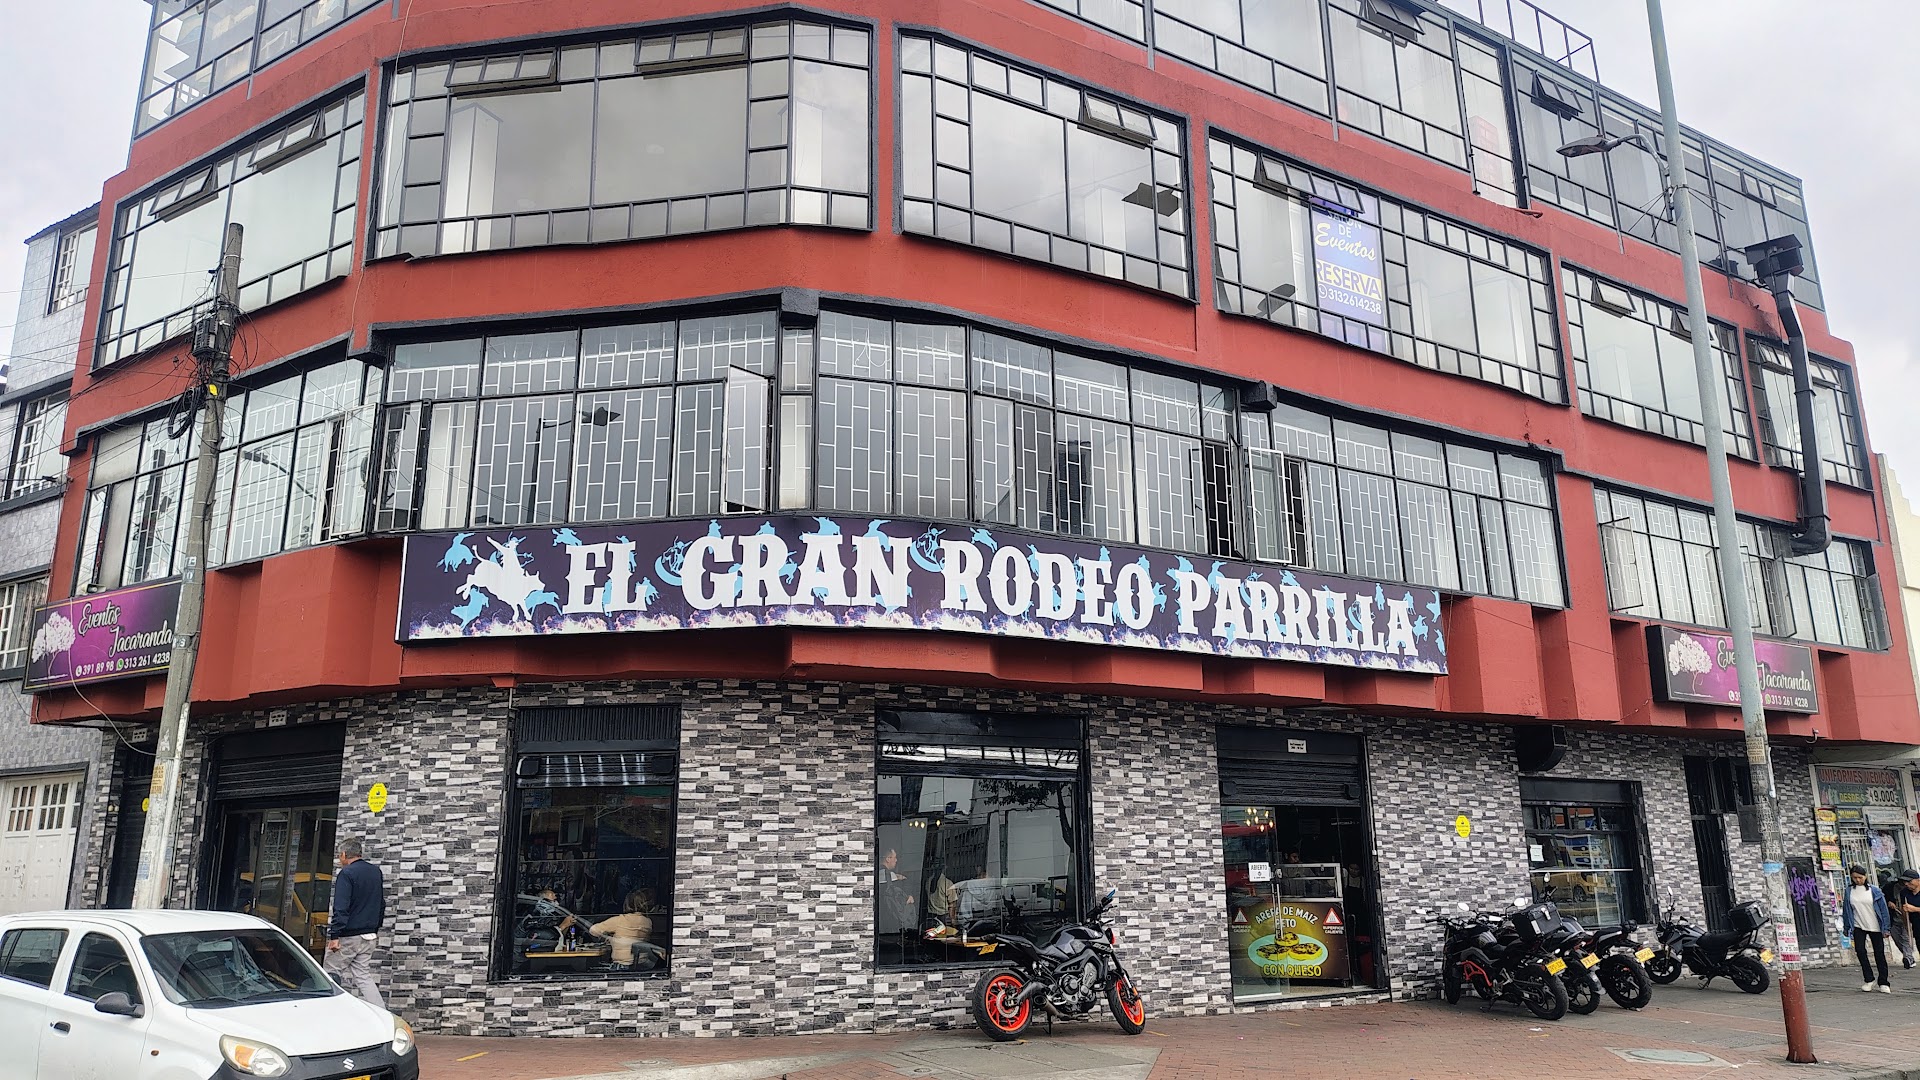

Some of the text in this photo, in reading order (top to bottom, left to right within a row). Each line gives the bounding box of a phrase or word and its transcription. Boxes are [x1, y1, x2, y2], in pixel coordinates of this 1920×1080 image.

[1315, 222, 1376, 261] Eventos
[1338, 224, 1352, 238] DE
[1317, 261, 1382, 300] RESERVA
[1328, 288, 1382, 315] 3132614238
[562, 534, 1419, 657] EL GRAN RODEO PARRILLA
[79, 601, 121, 637] Eventos
[109, 620, 172, 658] Jacaranda
[83, 651, 171, 676] 391 89 98 313 261 4238
[1757, 663, 1812, 692] Jacaranda
[1771, 694, 1783, 705] 313
[1783, 696, 1794, 707] 261
[1795, 697, 1809, 708] 4238
[1819, 768, 1863, 784] UNIFORMES
[1283, 906, 1294, 917] DE
[1263, 964, 1322, 977] CON QUESO
